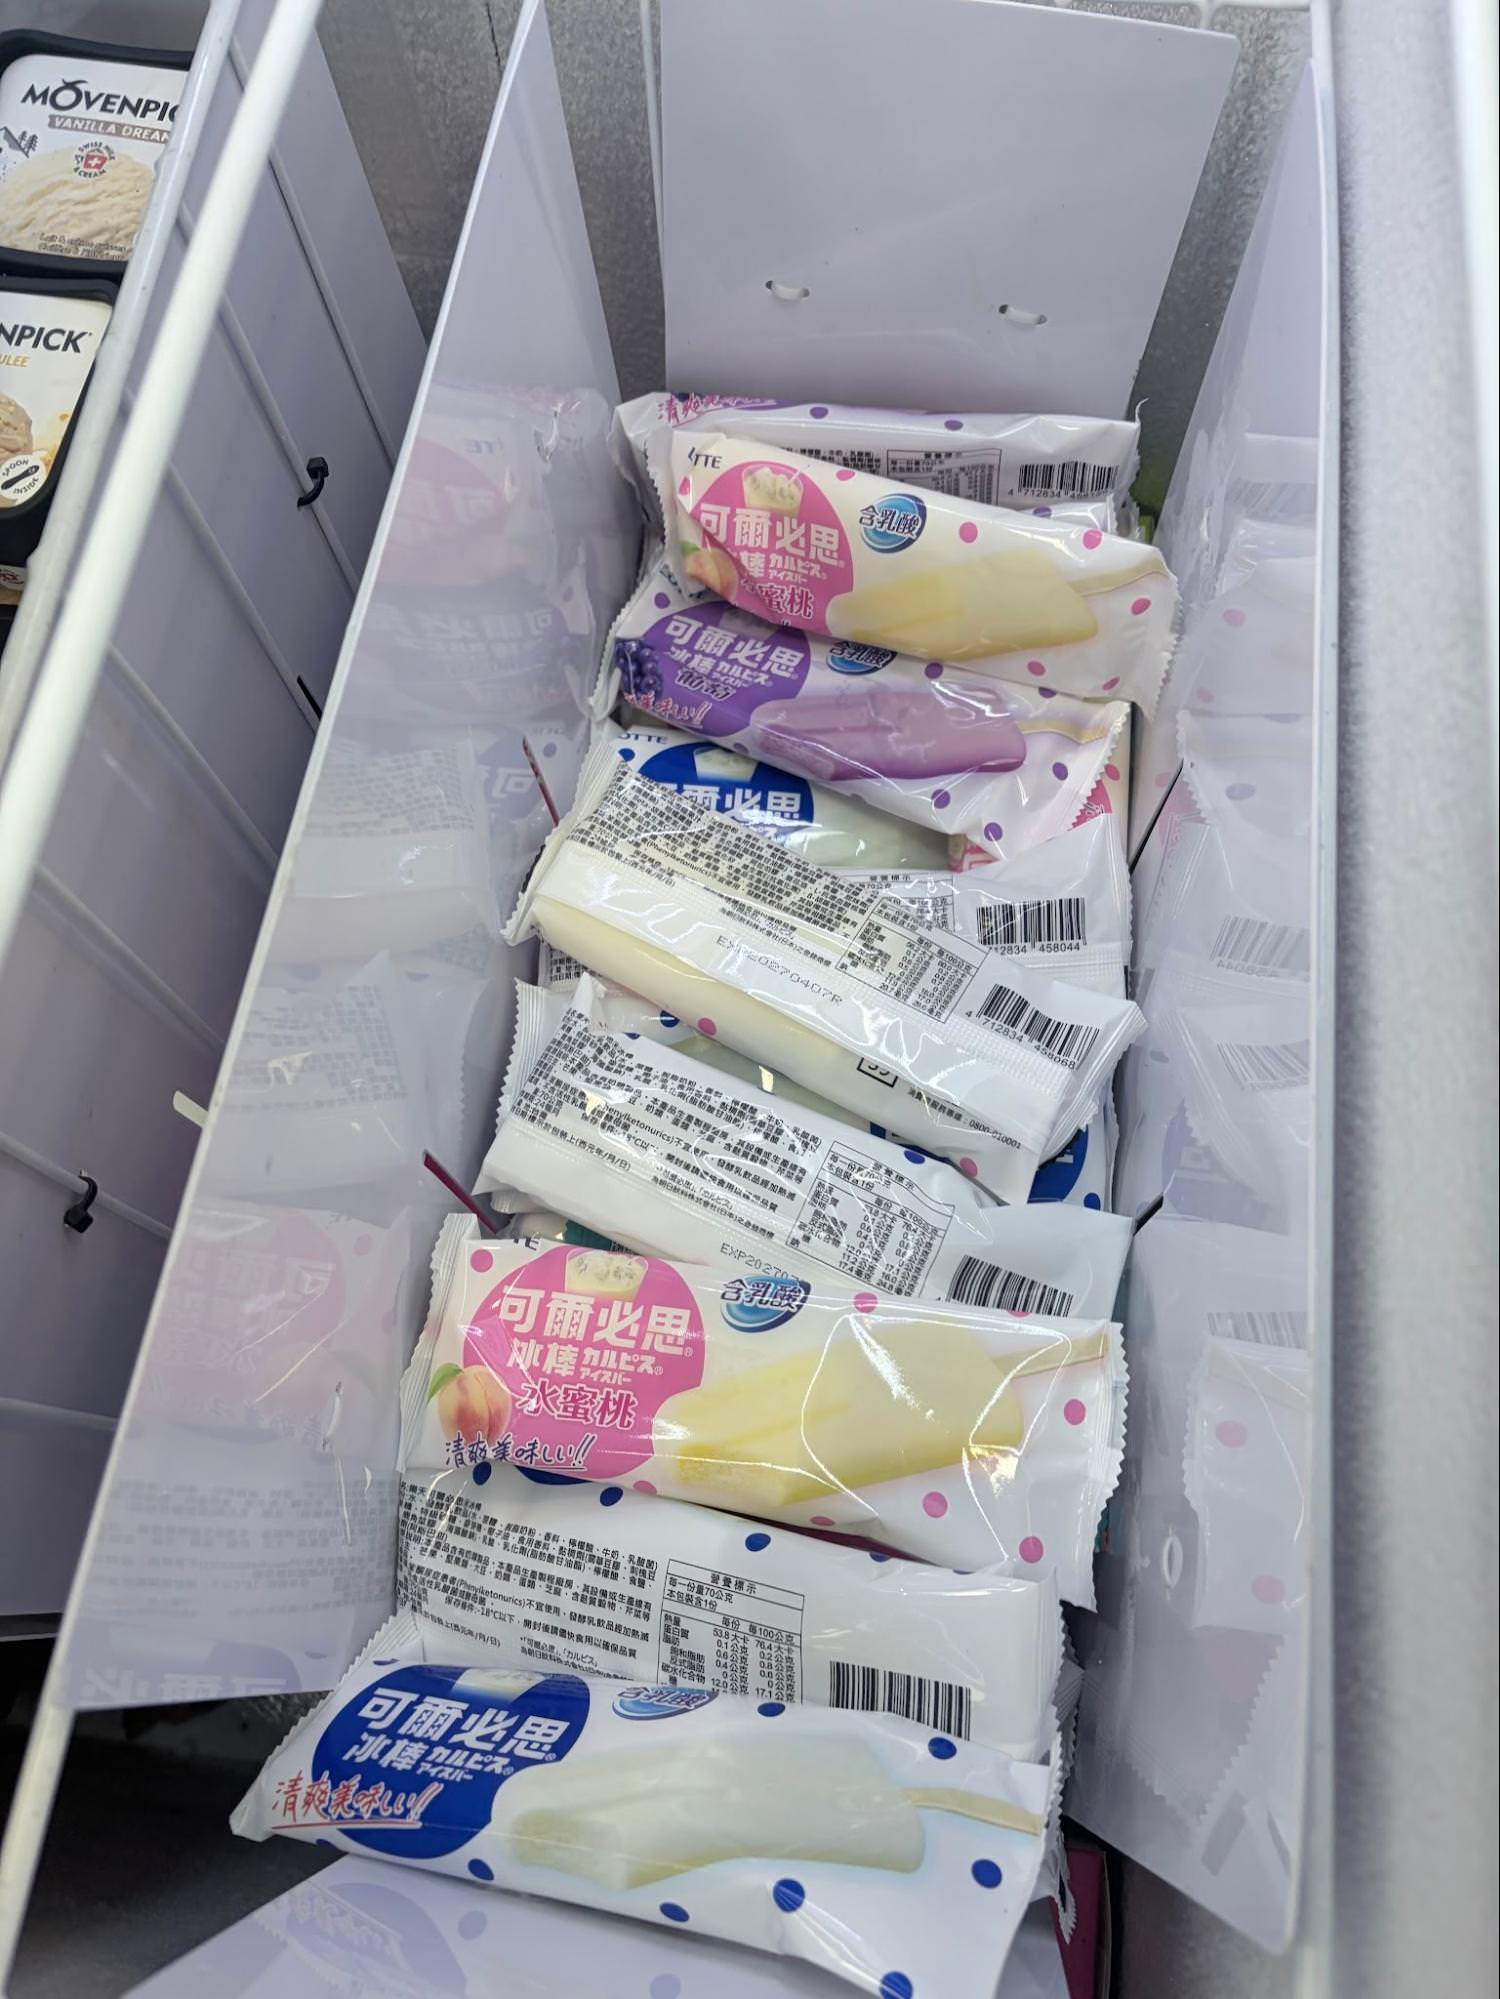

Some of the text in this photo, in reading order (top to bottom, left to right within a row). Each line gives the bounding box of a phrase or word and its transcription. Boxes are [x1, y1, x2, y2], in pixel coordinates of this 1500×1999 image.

[55, 116, 117, 135] VANILLA
[688, 446, 723, 469] LTTE
[701, 503, 840, 566] 可爾必思
[859, 504, 921, 539] 含乳酸
[724, 549, 764, 578] 棒
[665, 615, 805, 678] 可爾必思
[665, 646, 769, 687] 冰棒 カルピス
[617, 733, 667, 744] OTTE
[660, 782, 801, 823] 爾必思
[1038, 942, 1081, 953] 458044
[965, 1010, 973, 1018] 4
[982, 1018, 1024, 1043] 712834
[721, 1278, 801, 1312] 含乳酸
[499, 1285, 692, 1355] 可爾必思
[507, 1337, 656, 1377] 冰棒 カルピス
[579, 1366, 632, 1384] アイスバー
[516, 1377, 639, 1430] 水蜜桃
[669, 1576, 734, 1604] 每一份量70公克
[710, 1573, 756, 1594] 營養標示
[667, 1589, 717, 1611] 本包裝含1份
[663, 1624, 689, 1639] 蛋白質
[717, 1639, 728, 1648] 0.1
[731, 1643, 749, 1654] 公克
[760, 1650, 772, 1660] 0.2
[713, 1628, 730, 1639] 53.8
[731, 1632, 749, 1644] 大卡
[755, 1639, 772, 1651] 76.4
[722, 1616, 795, 1645] 每份 每100公克
[715, 1659, 728, 1669] 0.4
[730, 1663, 749, 1675] 公克
[716, 1650, 728, 1659] 0.6
[730, 1654, 749, 1665] 公克
[661, 1663, 705, 1684] 碳水化合物
[711, 1678, 728, 1688] 12.0
[756, 1687, 772, 1699] 17.1
[722, 1670, 728, 1678] 0
[730, 1672, 749, 1684] 公克
[768, 1680, 773, 1688] 0
[358, 1688, 571, 1760] 可爾必思
[343, 1733, 506, 1775] 冰棒 カルピス
[416, 1762, 473, 1782] アイスバー
